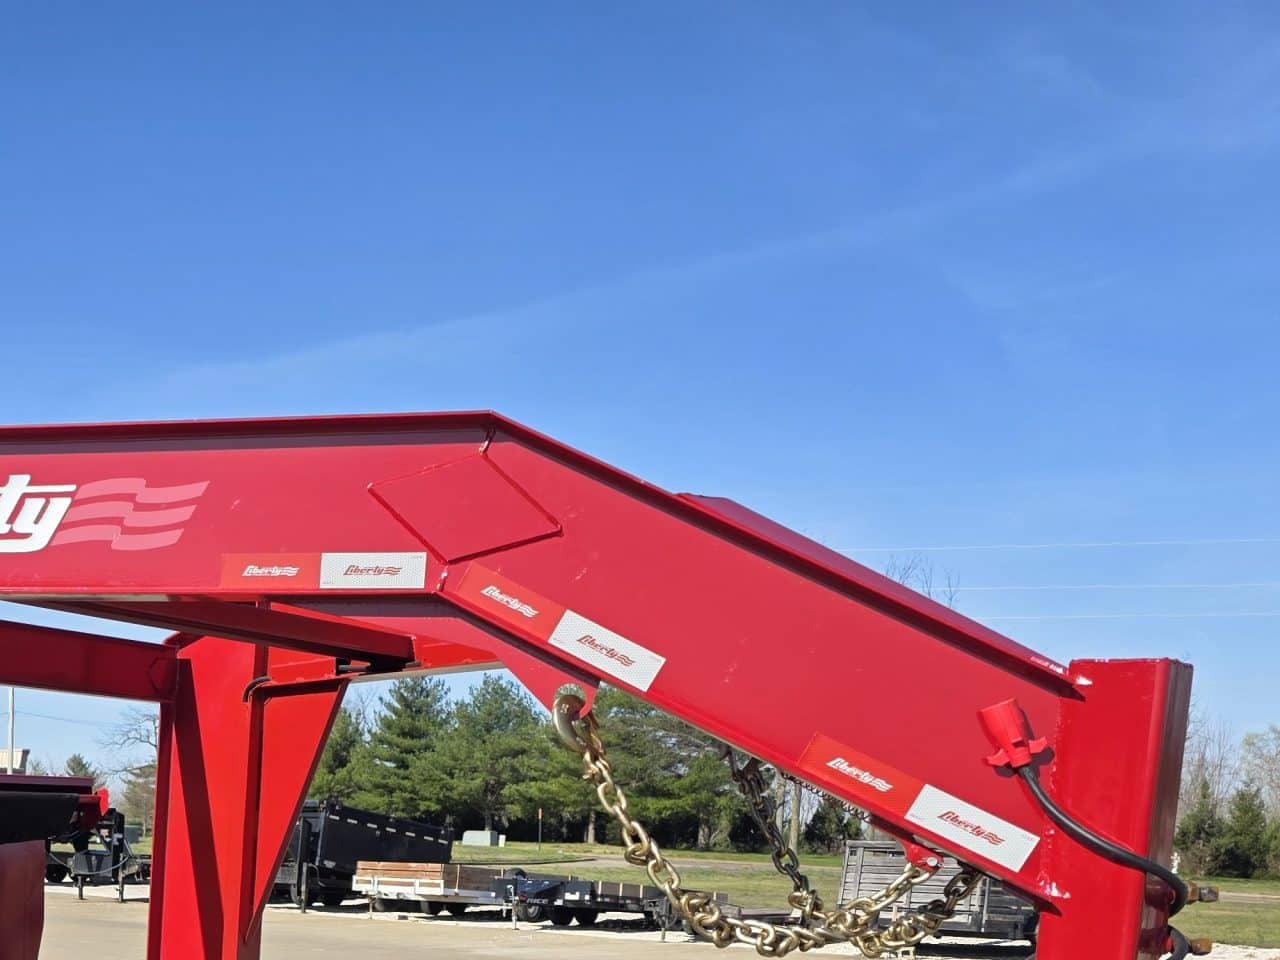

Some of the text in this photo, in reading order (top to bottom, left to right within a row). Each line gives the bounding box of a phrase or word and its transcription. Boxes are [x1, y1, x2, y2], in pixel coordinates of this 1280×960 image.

[242, 565, 283, 577] Liberty
[343, 564, 385, 576] Liberty
[480, 585, 521, 611] Liberty
[576, 634, 618, 660] Liberty
[826, 757, 871, 785] Liberty
[937, 811, 986, 838] Liberty
